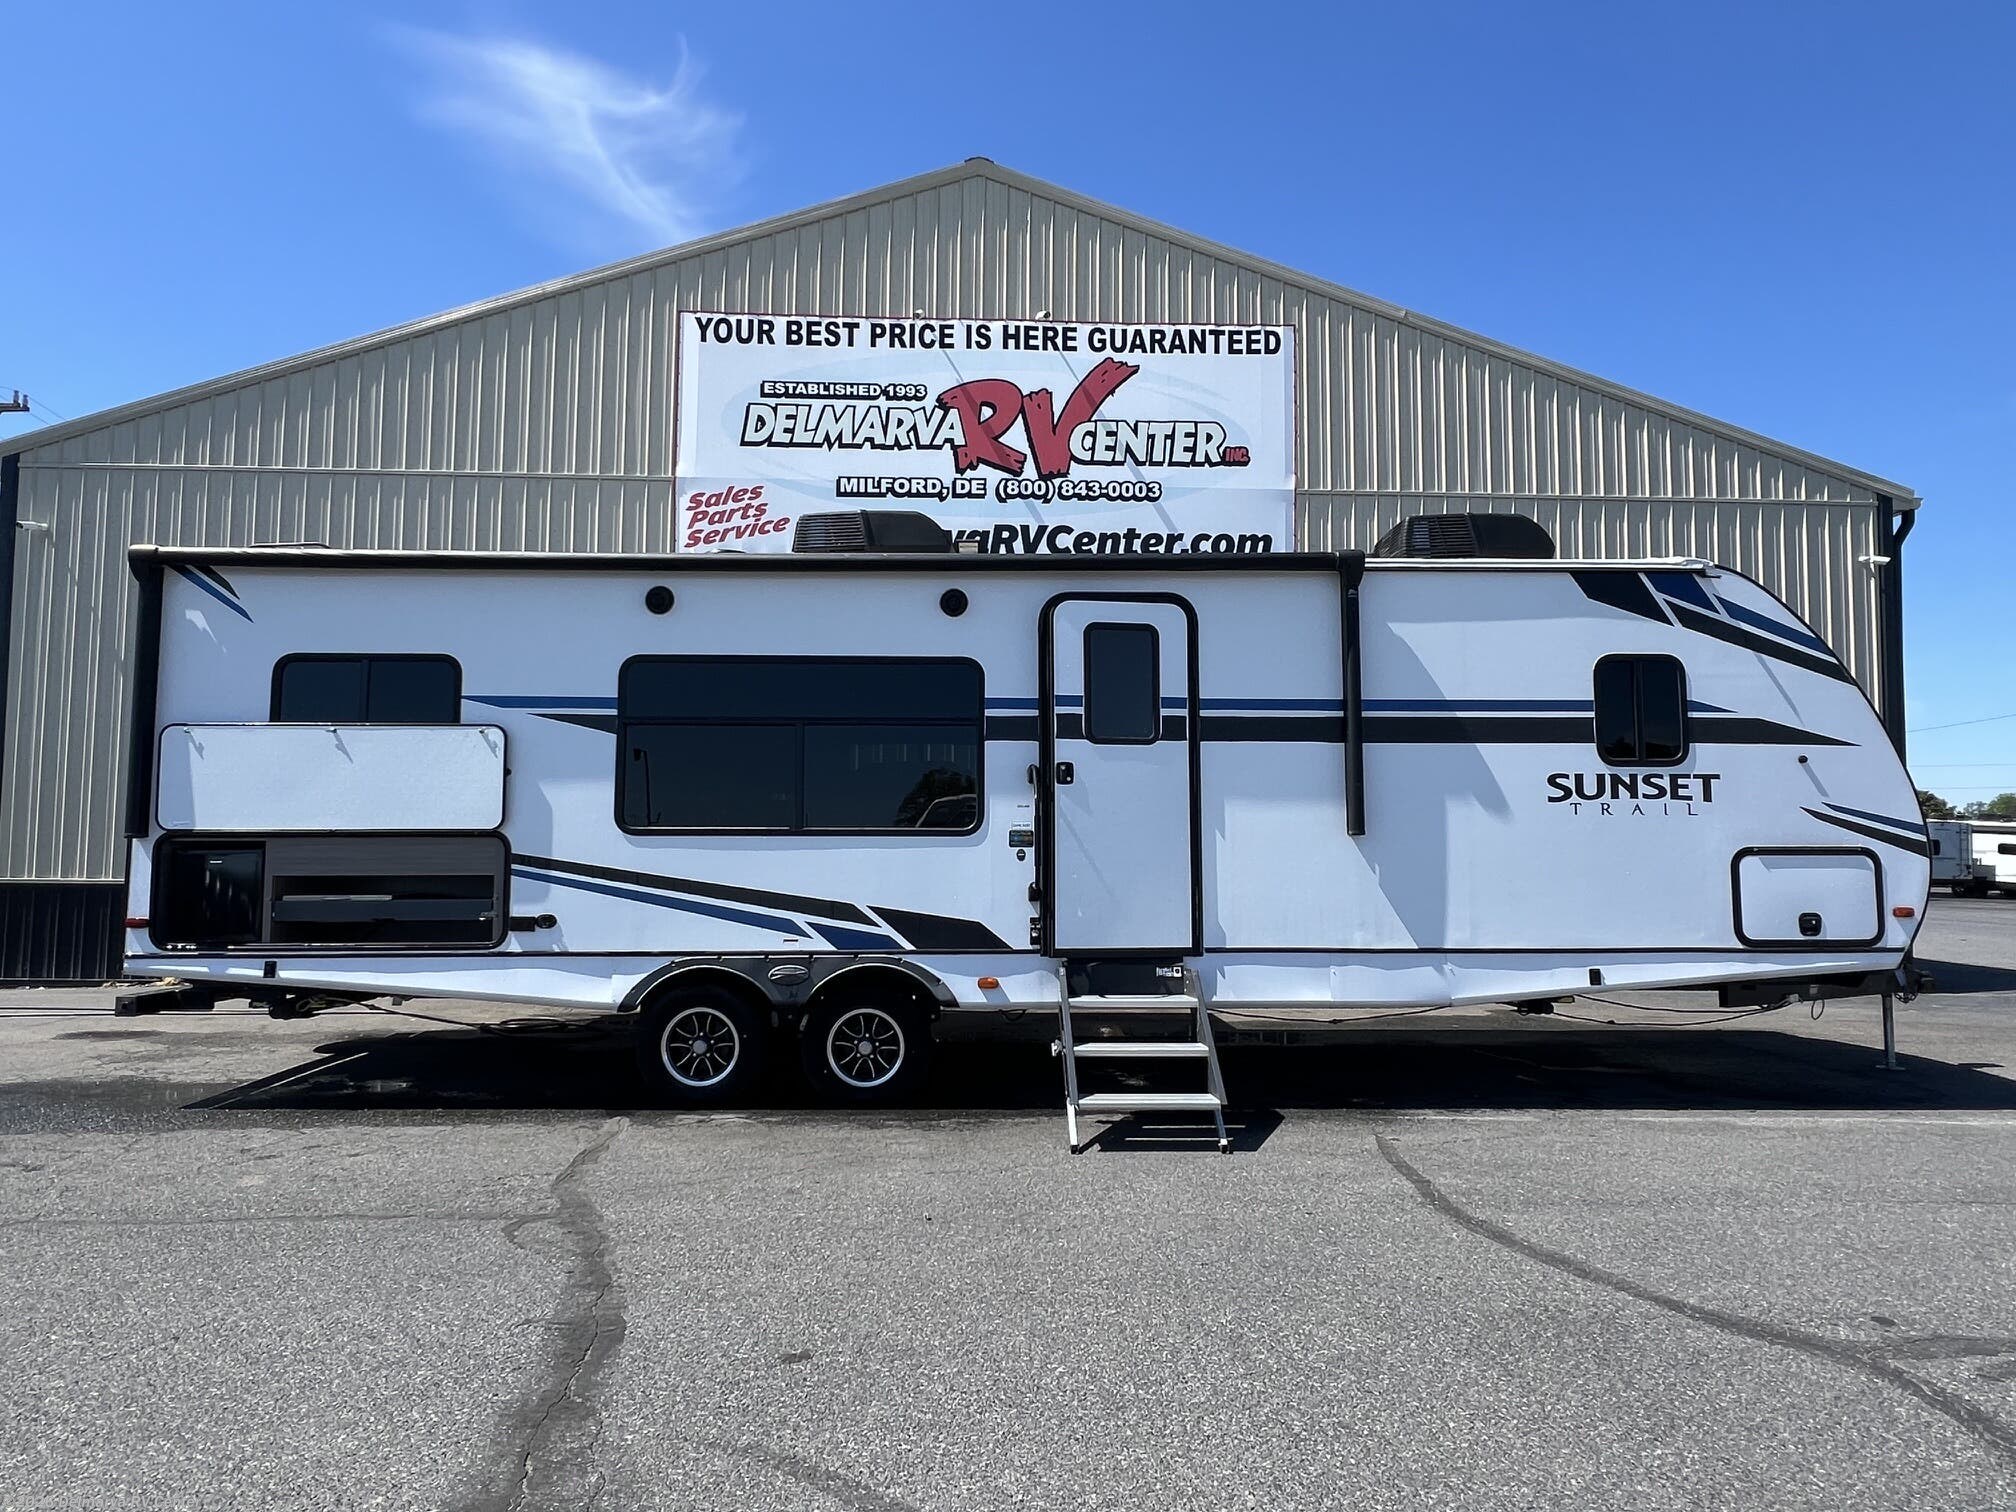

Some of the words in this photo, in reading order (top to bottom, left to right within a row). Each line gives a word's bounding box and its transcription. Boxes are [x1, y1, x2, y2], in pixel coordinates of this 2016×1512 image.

[694, 316, 776, 346] YOUR
[785, 319, 860, 348] BEST
[869, 321, 955, 350] PRICE
[965, 323, 992, 350] IS
[1002, 324, 1078, 351] HERE
[1087, 326, 1282, 356] GUARANTEED
[762, 382, 882, 399] ESTABLISHED
[885, 385, 928, 399] 1993
[741, 403, 967, 450] DELMARVA
[936, 357, 1140, 478] RV
[1069, 420, 1226, 466] CENTER
[685, 485, 765, 511] Sales
[838, 477, 949, 501] MILFORD,
[954, 478, 987, 498] DE
[997, 479, 1055, 503] (800)
[1060, 480, 1162, 501] 843-0003
[687, 502, 769, 529] Parts
[684, 517, 791, 548] Service
[1546, 772, 1721, 803] SUNSET
[1569, 802, 1699, 816] TRAIL
